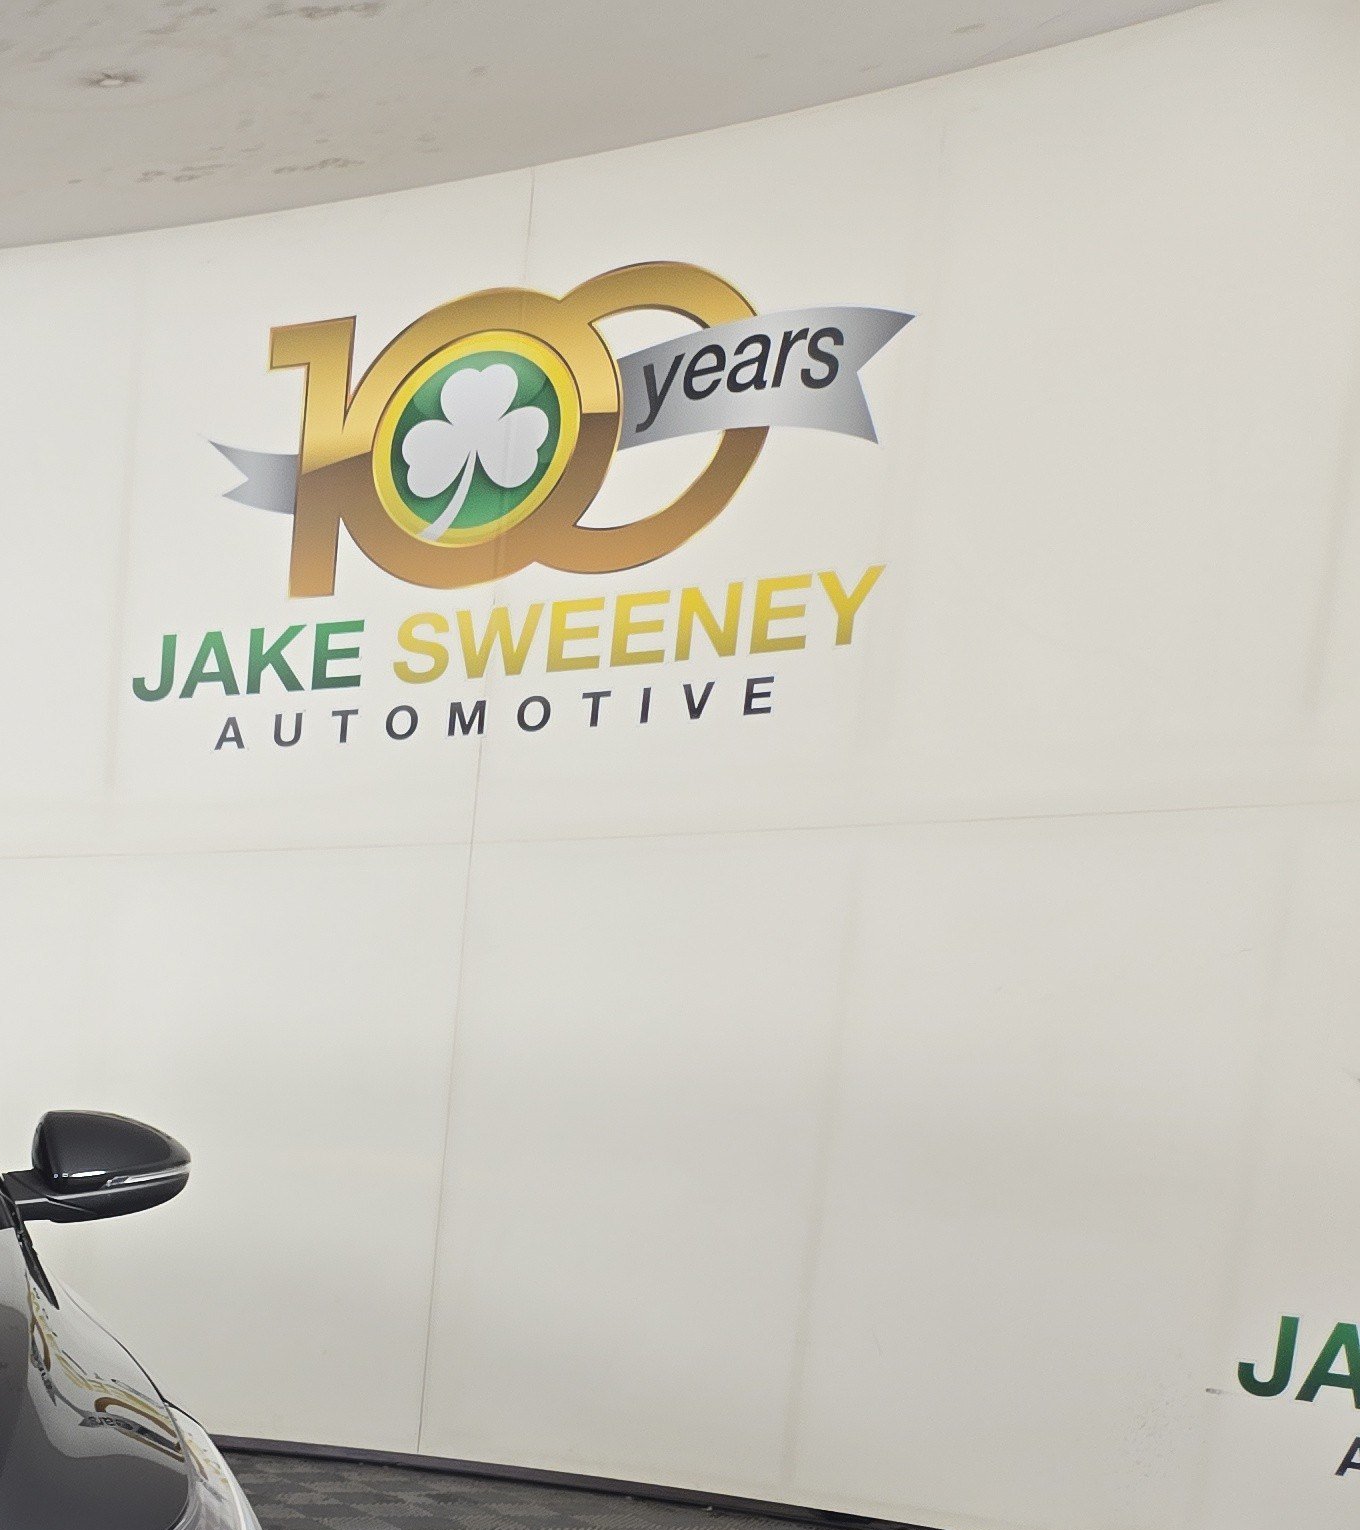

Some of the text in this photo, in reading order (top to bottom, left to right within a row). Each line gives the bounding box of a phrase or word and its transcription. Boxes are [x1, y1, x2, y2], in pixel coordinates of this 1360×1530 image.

[635, 324, 845, 433] years
[132, 565, 886, 703] JAKE SWEENEY
[215, 676, 776, 752] AUTOMOTIVE
